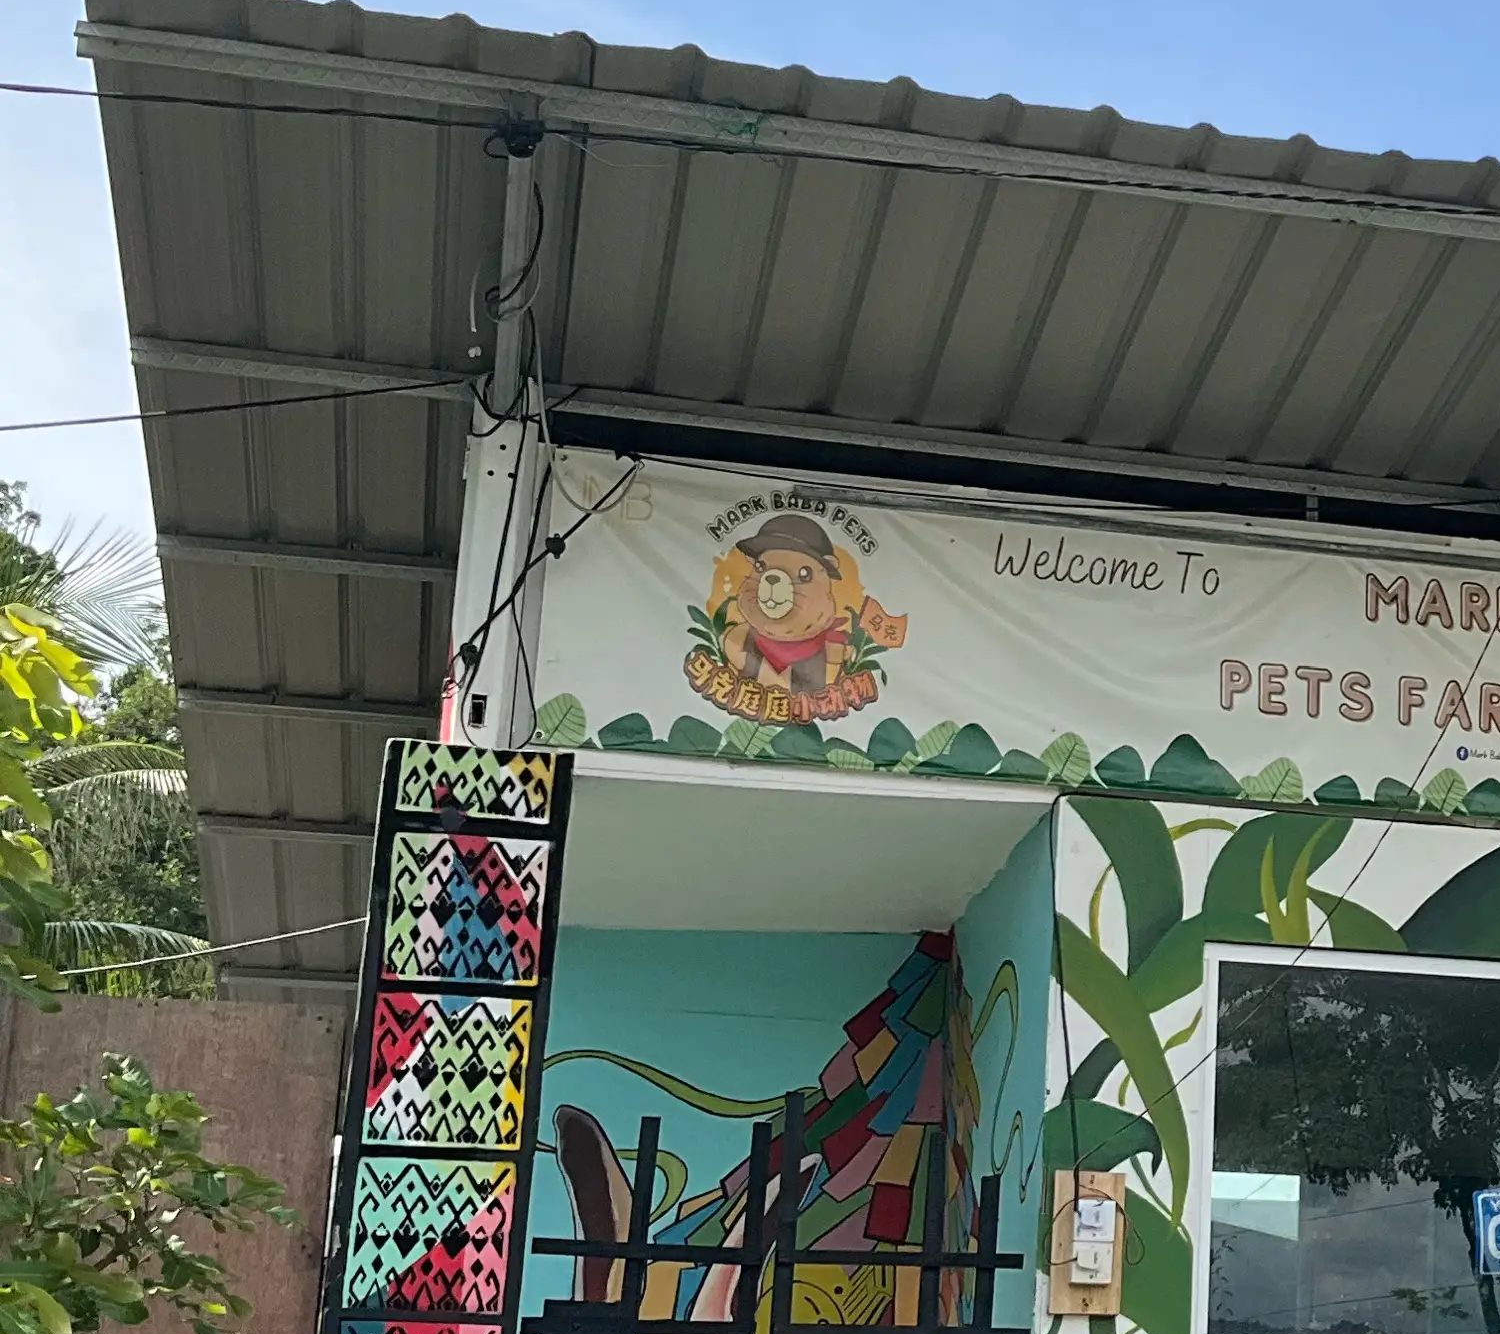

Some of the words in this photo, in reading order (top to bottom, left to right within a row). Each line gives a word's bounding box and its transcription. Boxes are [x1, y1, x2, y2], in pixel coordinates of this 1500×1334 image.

[707, 495, 767, 542] MARK
[771, 491, 828, 517] BABA
[831, 506, 879, 556] PETS
[992, 532, 1166, 593] Welcome
[1173, 549, 1222, 596] To
[1218, 658, 1375, 722] PETS
